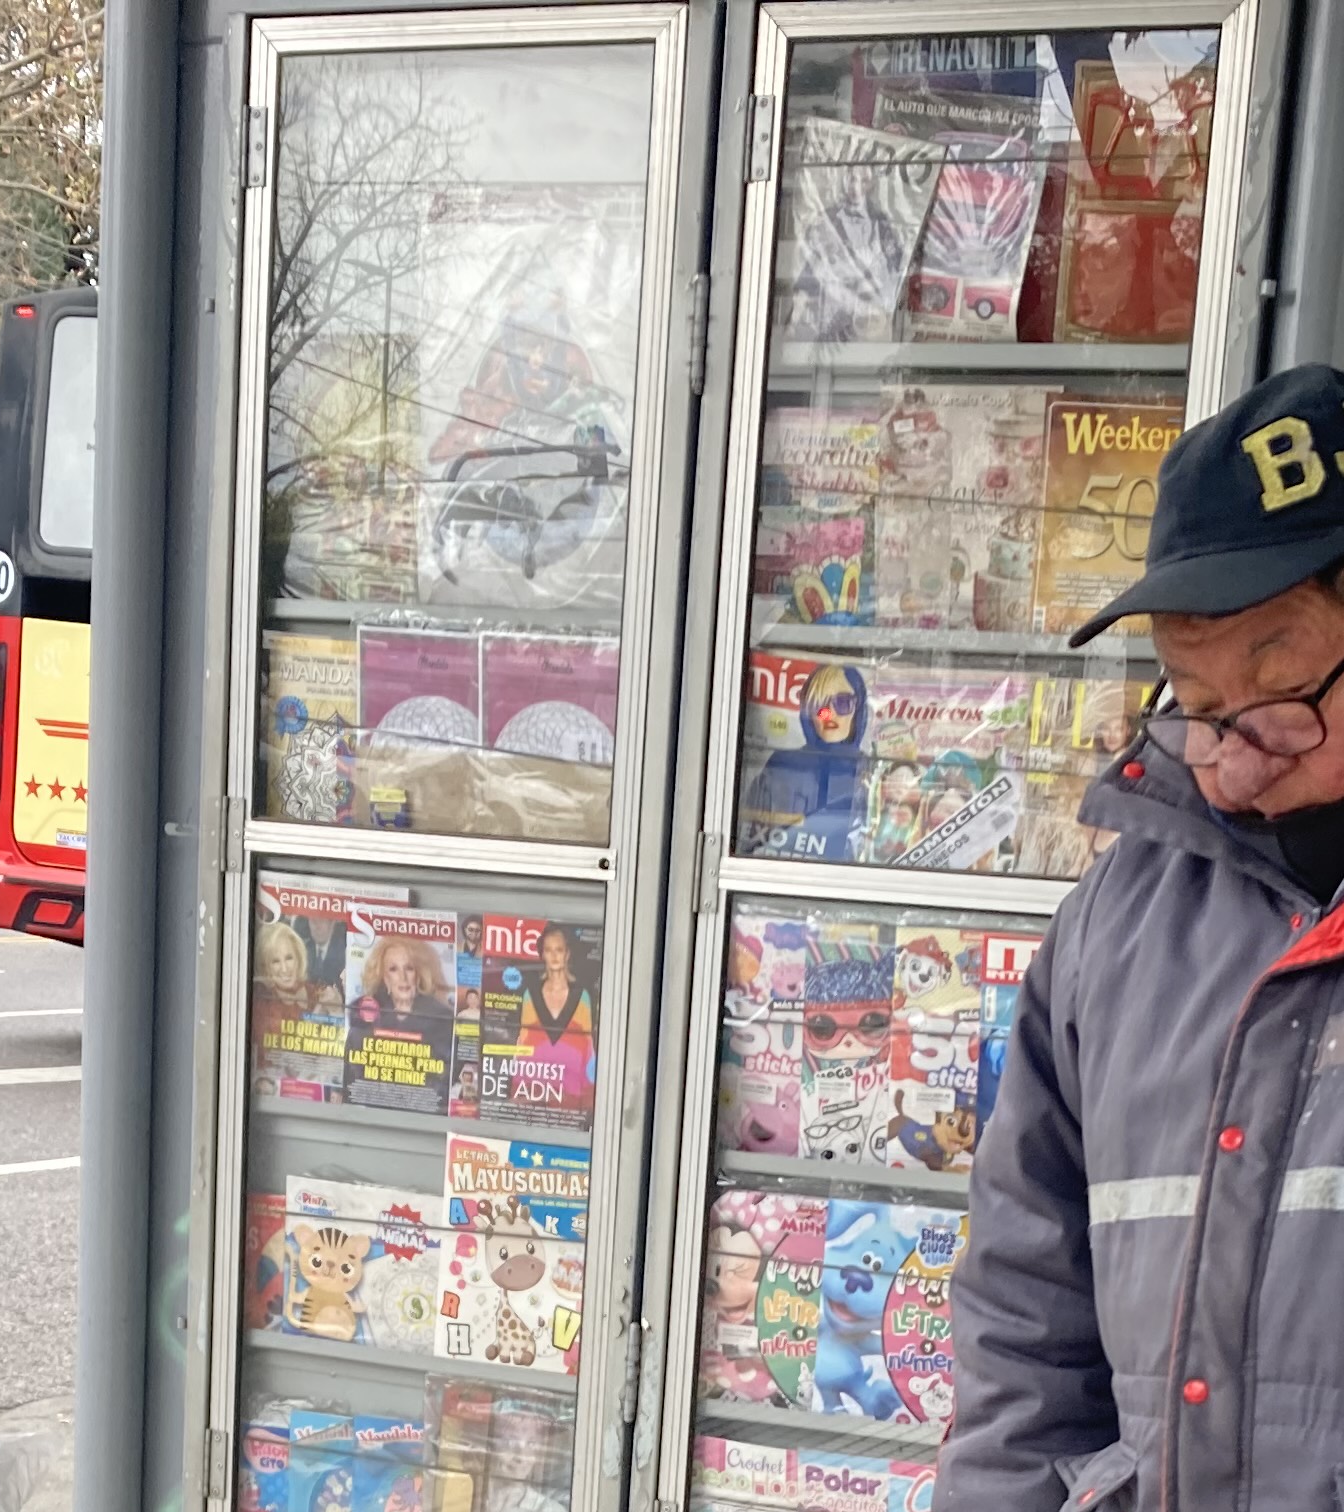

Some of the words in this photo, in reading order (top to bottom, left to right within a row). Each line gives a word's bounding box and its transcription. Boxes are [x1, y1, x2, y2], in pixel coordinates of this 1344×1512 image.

[898, 100, 926, 114] AUTO
[927, 103, 947, 117] QUE
[1071, 472, 1156, 562] 50
[794, 831, 827, 856] EN
[351, 907, 452, 948] Semanario
[484, 919, 544, 958] mía
[495, 1001, 519, 1011] COLOR
[280, 1019, 295, 1035] LO
[297, 1021, 319, 1038] QUE
[263, 1033, 278, 1048] DE
[281, 1035, 302, 1052] LOS
[363, 1037, 375, 1053] LE
[376, 1039, 431, 1059] CORTARON
[349, 1049, 369, 1067] LAS
[417, 1056, 444, 1075] PERO
[482, 1056, 496, 1075] EL
[499, 1058, 567, 1083] AUTOTEST
[364, 1067, 380, 1082] NO
[381, 1069, 394, 1083] SE
[395, 1070, 427, 1087] RINDE
[482, 1074, 509, 1098] DE
[513, 1080, 564, 1105] ADN
[456, 1149, 497, 1165] LETRAS
[376, 1225, 427, 1251] ANIMAL
[545, 1214, 560, 1236] K
[447, 1322, 472, 1356] H
[552, 1305, 582, 1352] V
[727, 1447, 784, 1475] Crochet
[805, 1464, 883, 1496] Polar
